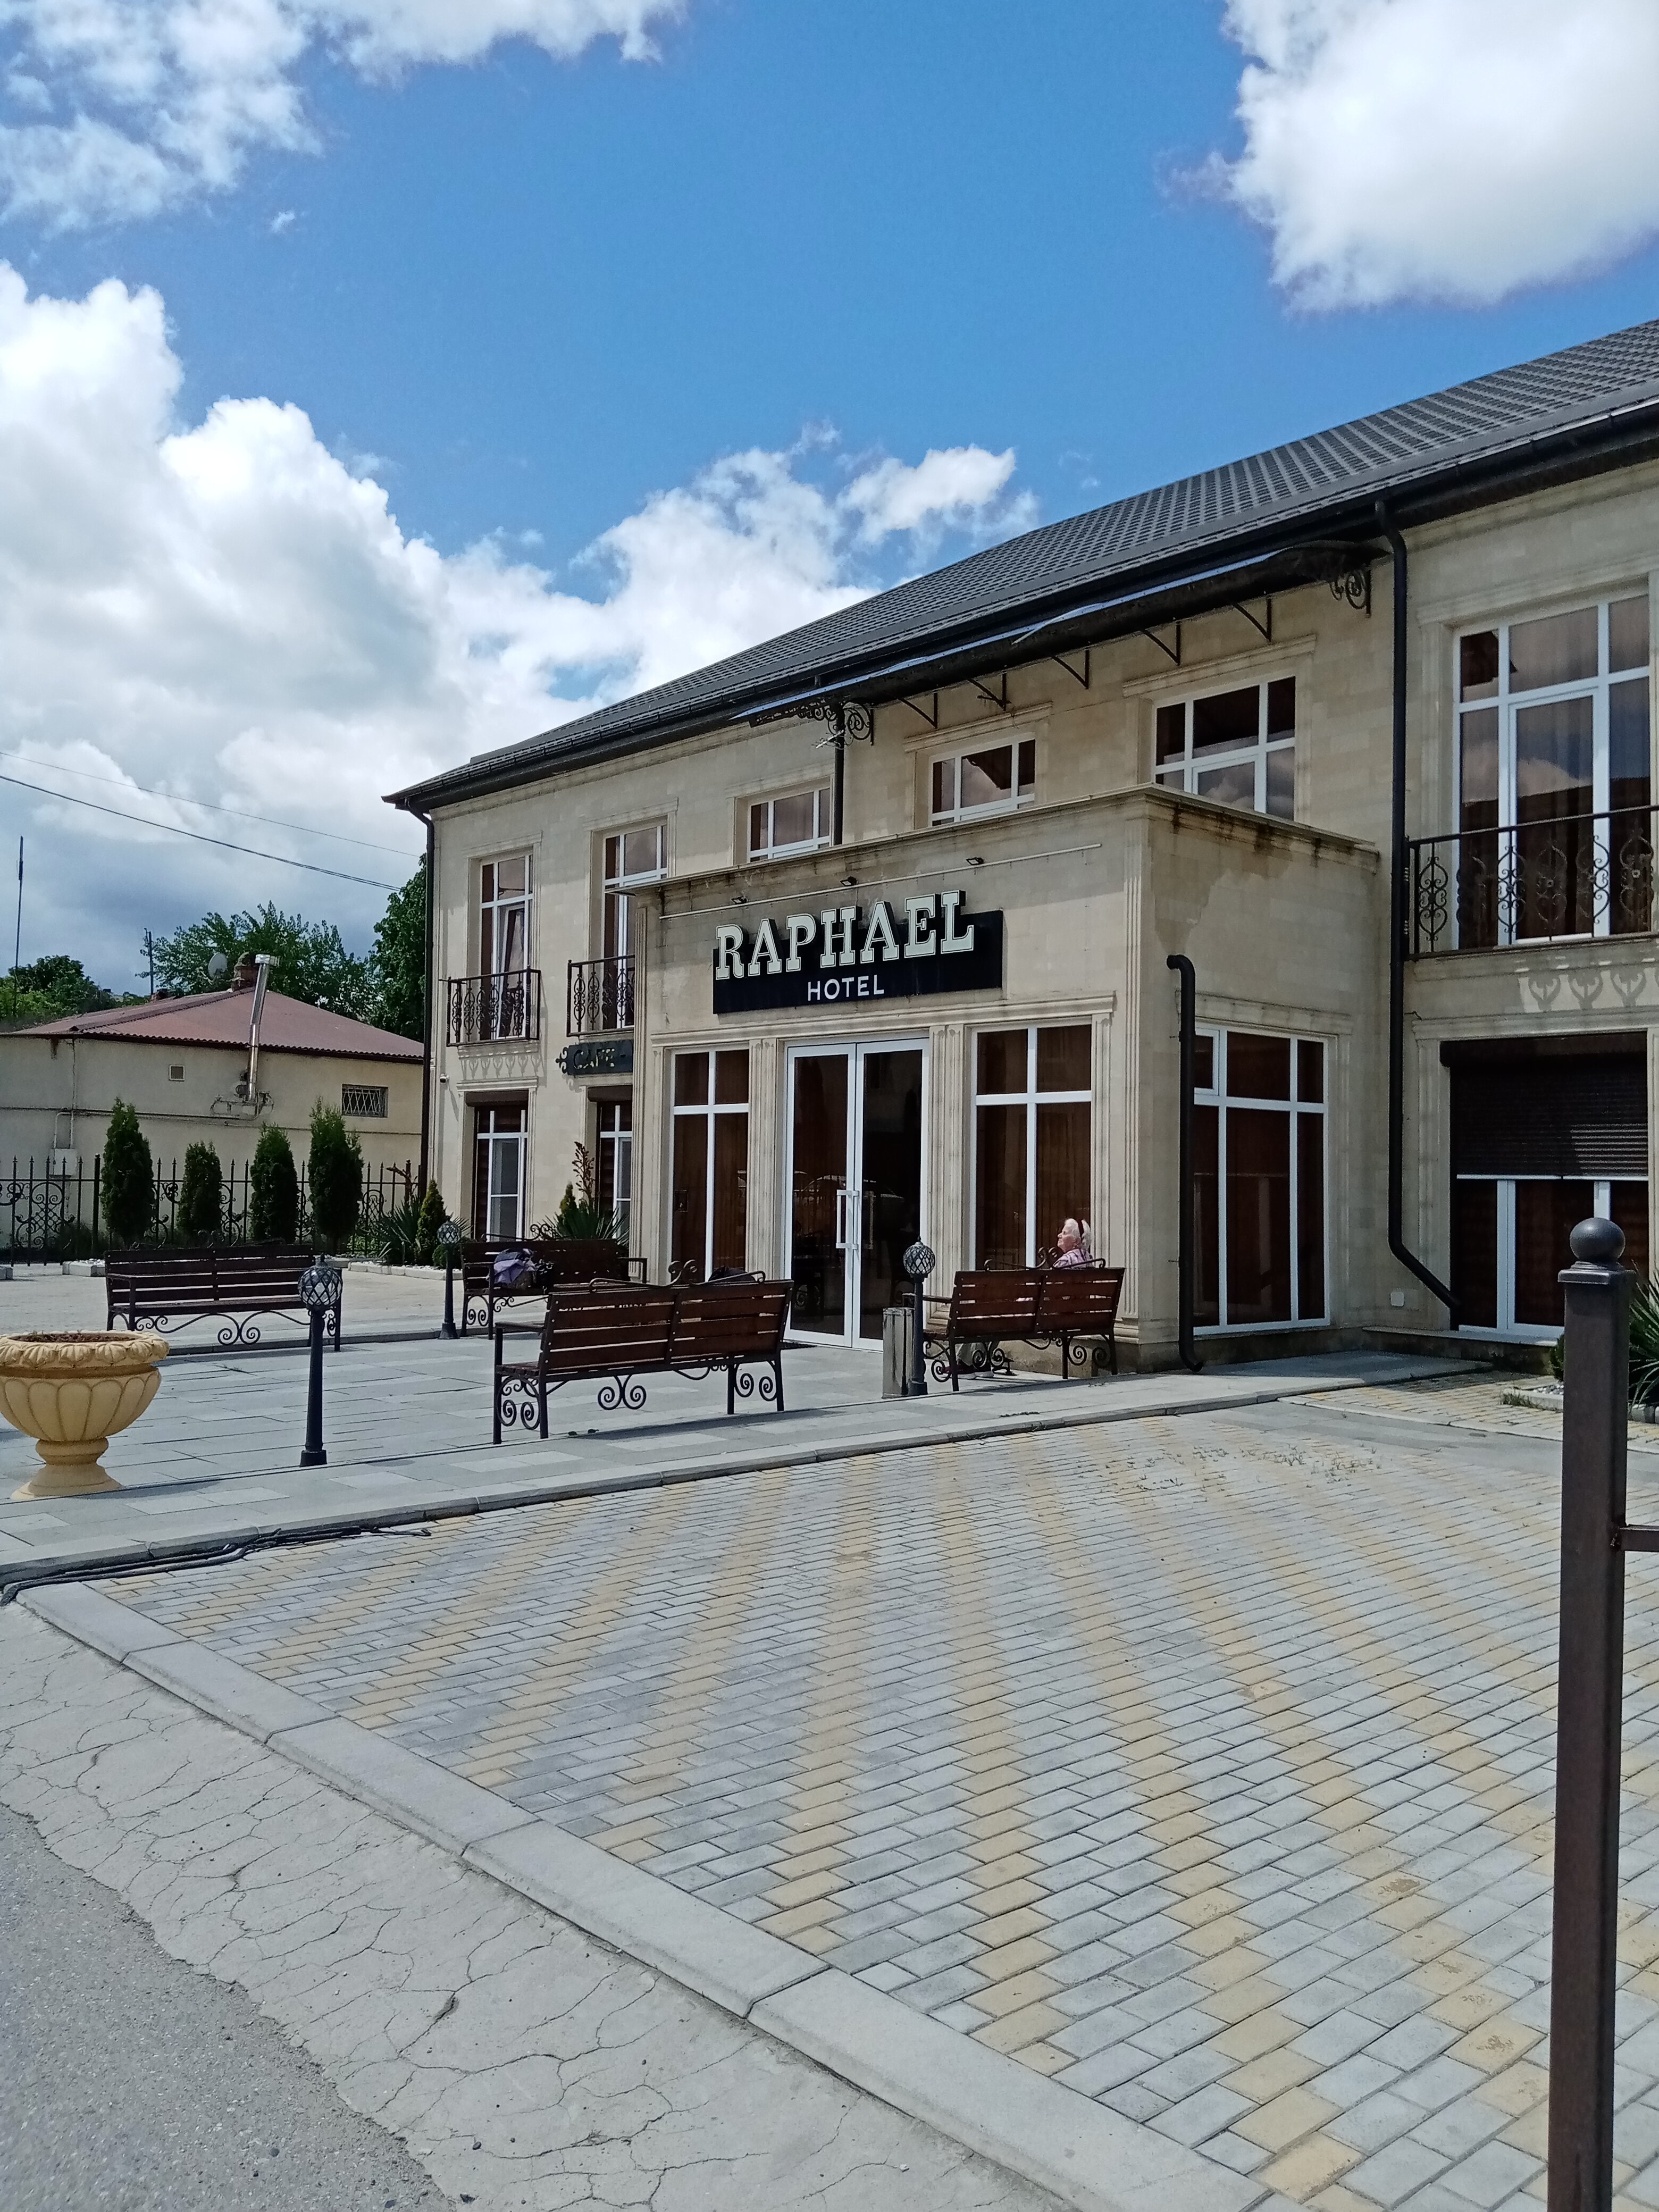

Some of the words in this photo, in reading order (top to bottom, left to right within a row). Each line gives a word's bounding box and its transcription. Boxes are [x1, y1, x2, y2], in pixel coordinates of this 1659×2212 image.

[715, 890, 974, 981] RAPHAEL
[808, 974, 884, 1001] HOTEL
[573, 1048, 615, 1070] CAFE
